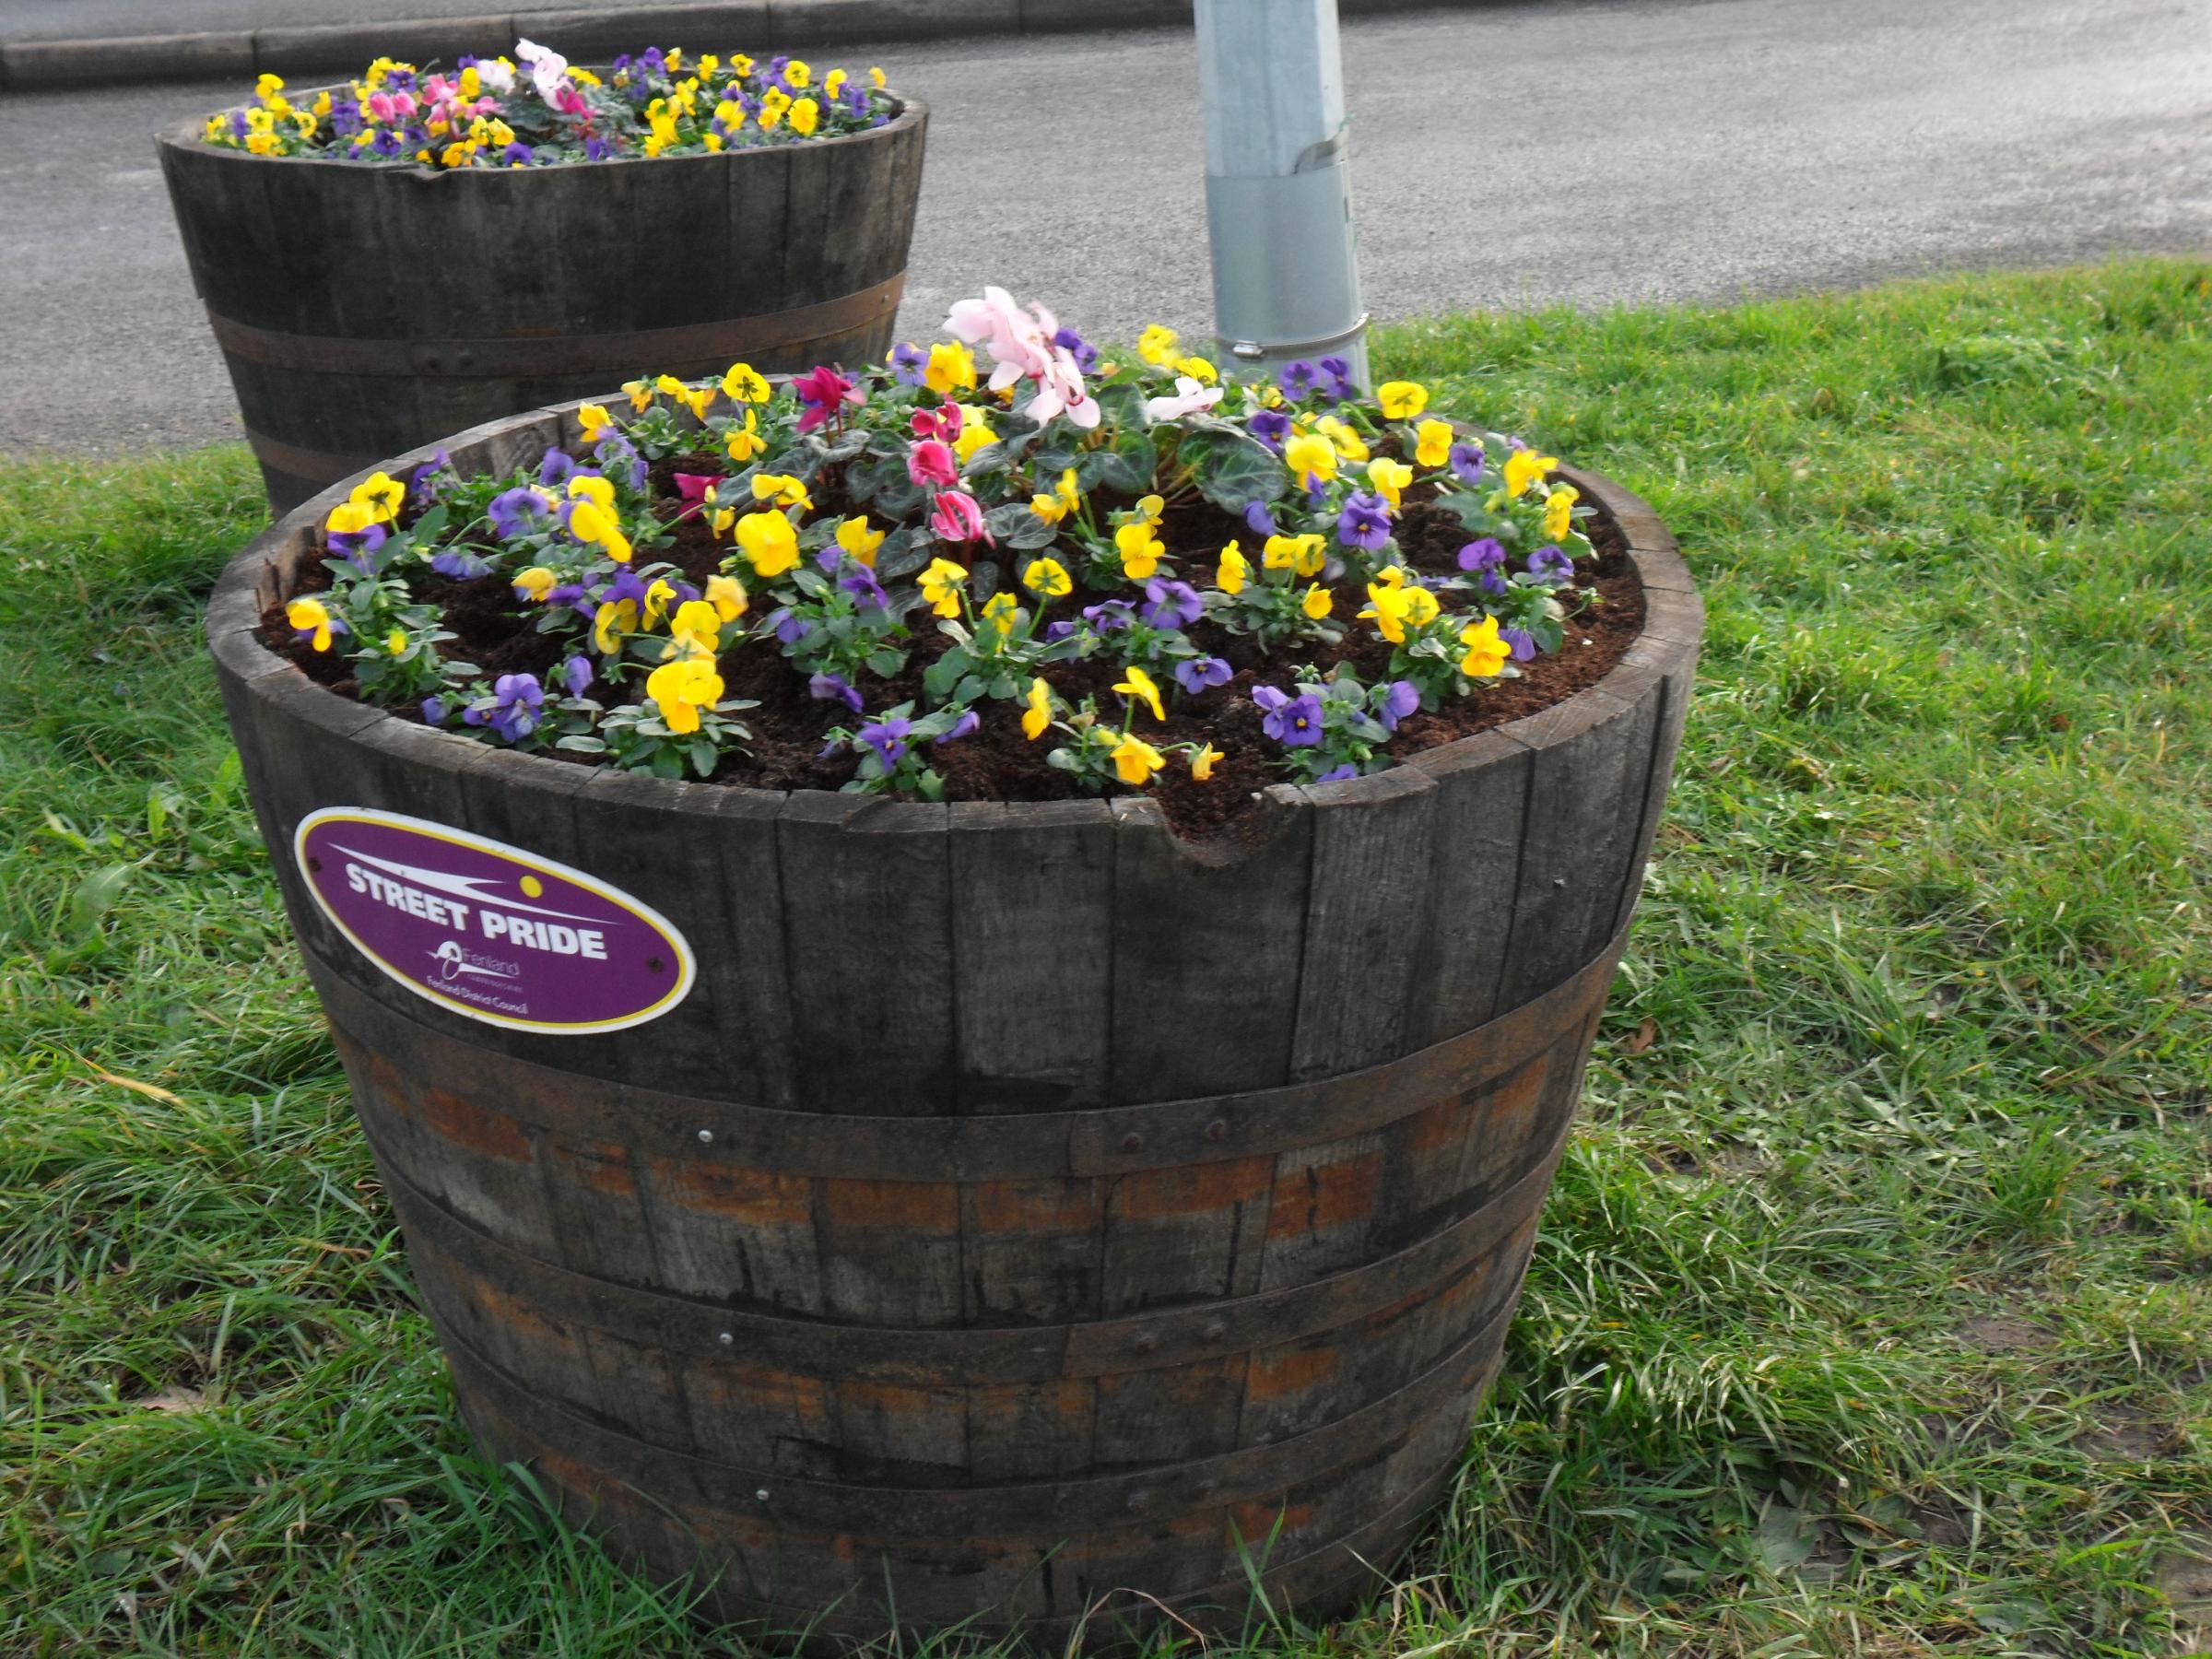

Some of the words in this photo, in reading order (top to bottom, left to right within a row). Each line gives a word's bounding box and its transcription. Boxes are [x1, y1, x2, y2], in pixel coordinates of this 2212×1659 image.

[345, 863, 468, 931] STREET
[479, 910, 608, 960] PRIDE
[462, 947, 521, 976] Fenland
[492, 996, 529, 1015] Council
